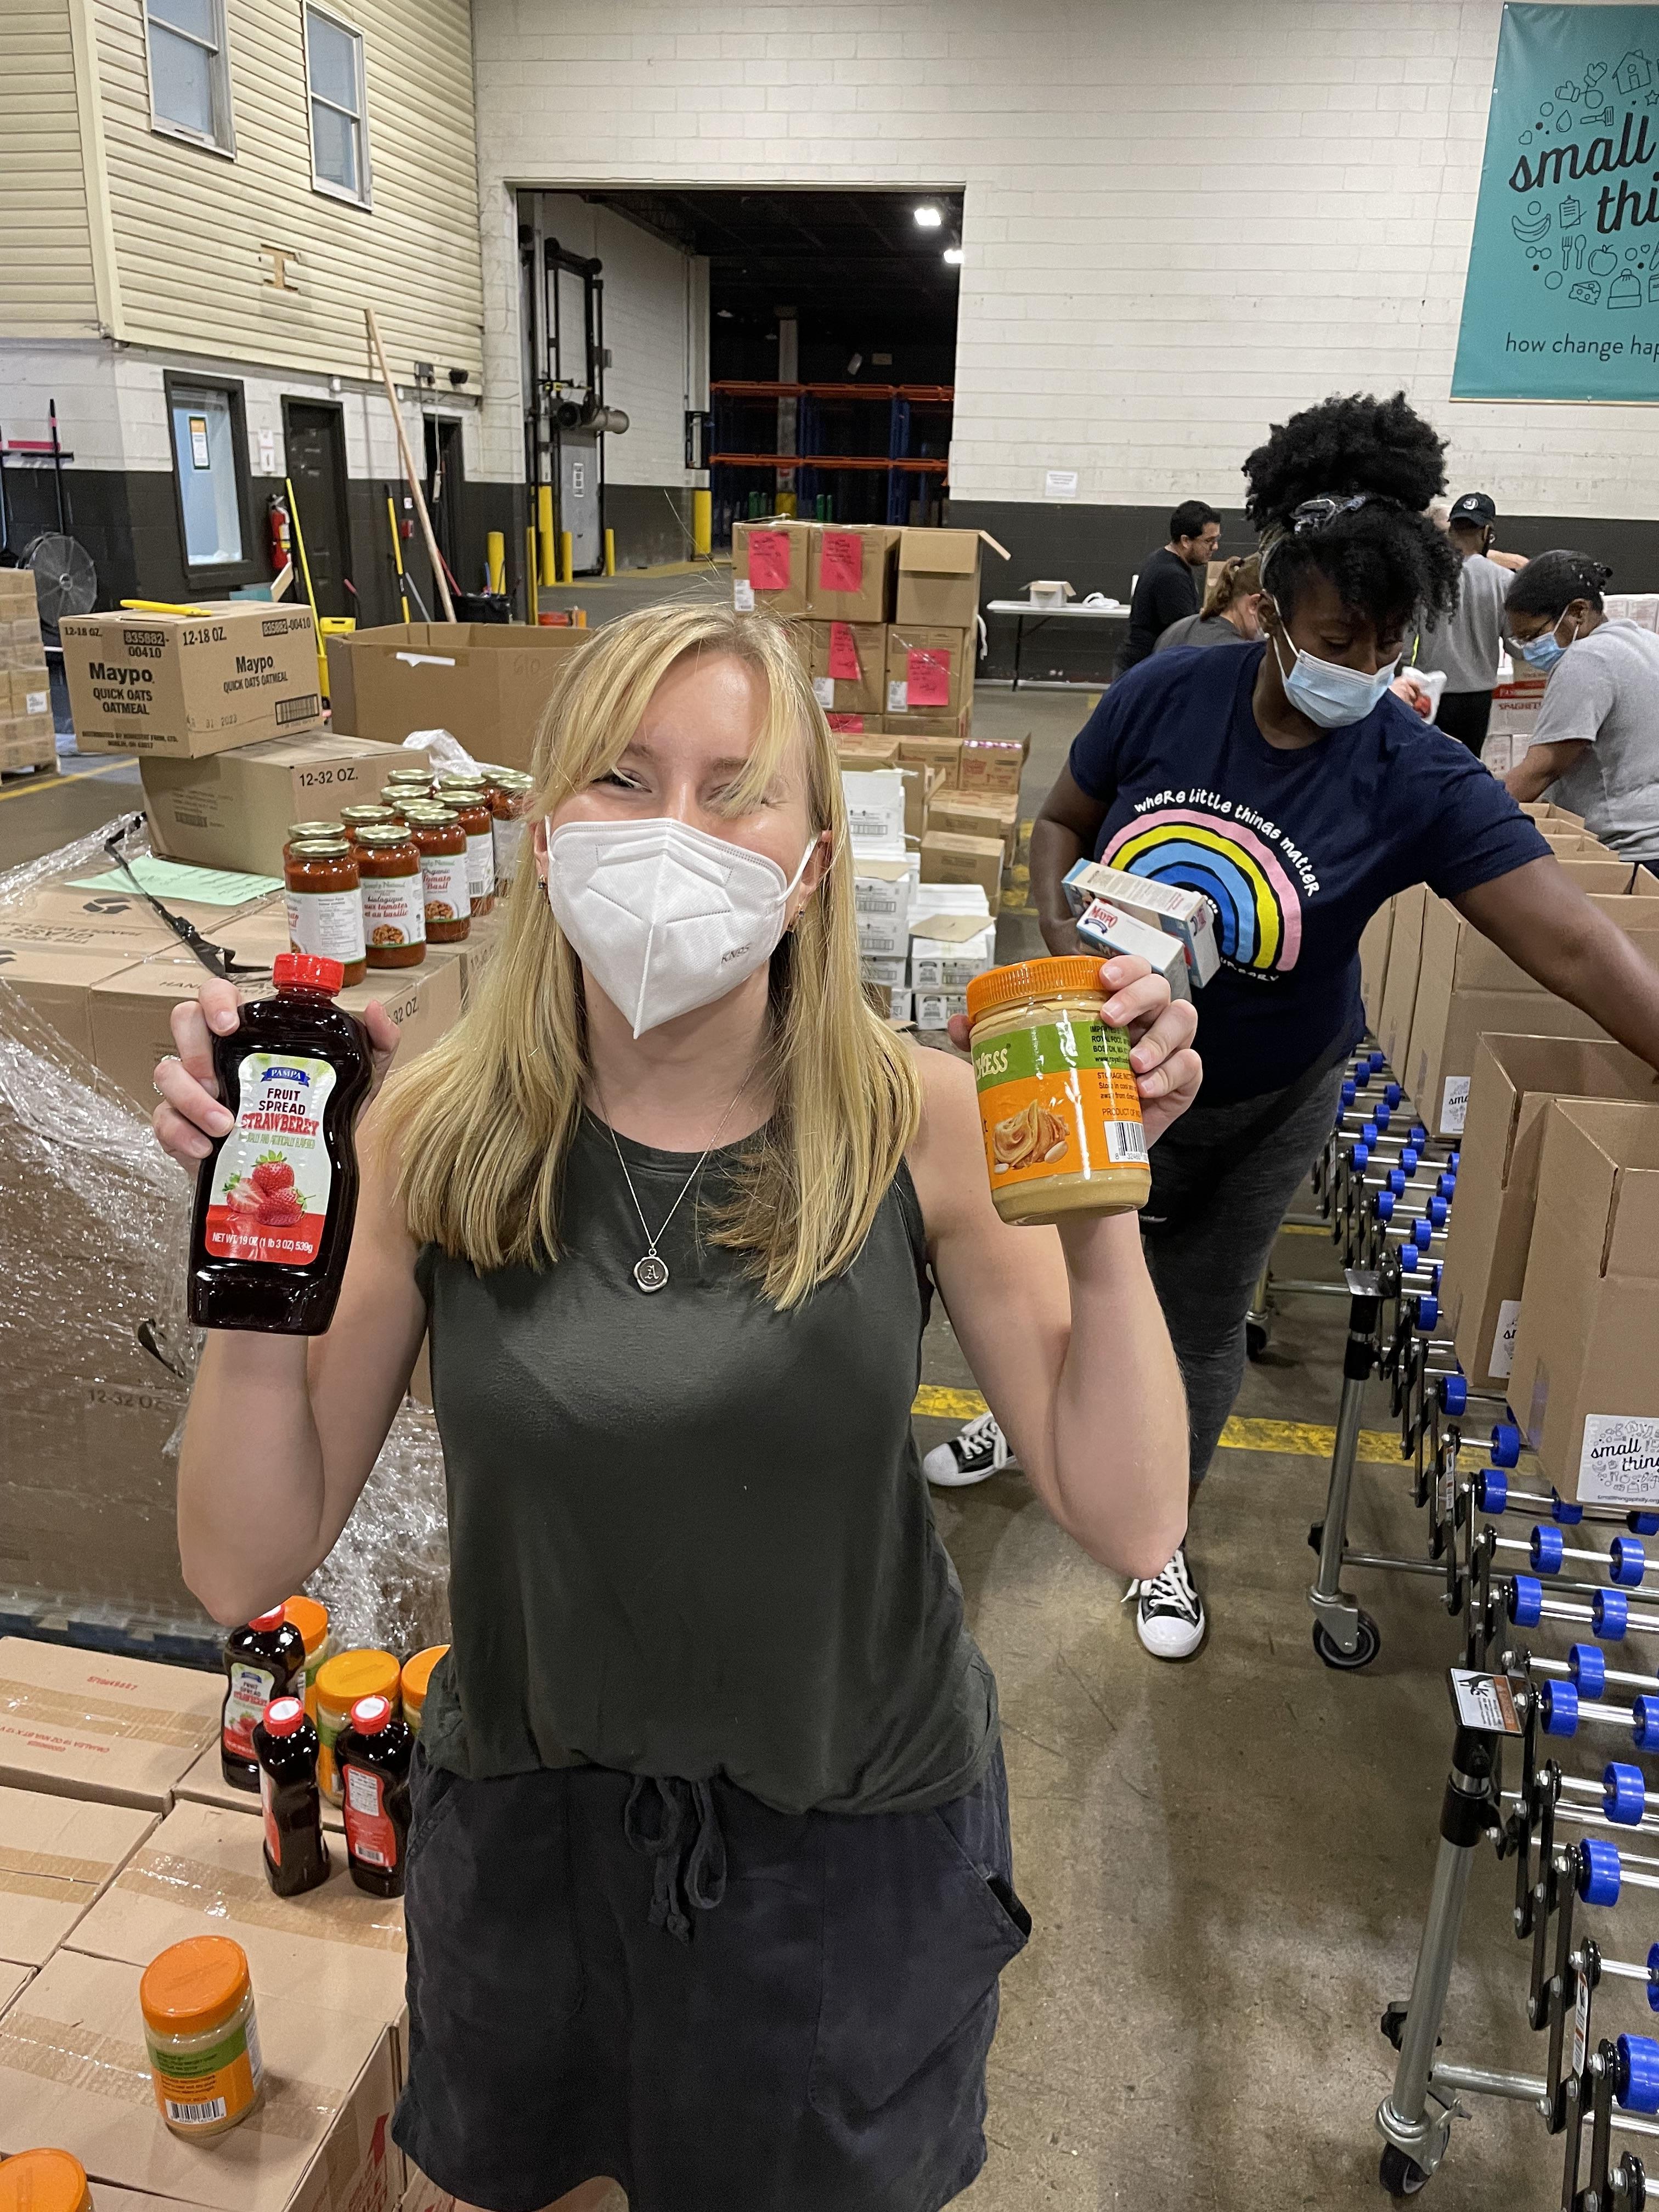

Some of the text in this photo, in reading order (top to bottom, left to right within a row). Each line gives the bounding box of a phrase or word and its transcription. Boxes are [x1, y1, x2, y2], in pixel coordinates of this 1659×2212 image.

[1509, 112, 1657, 193] small
[1506, 332, 1546, 352] how
[1553, 333, 1623, 362] change
[183, 628, 210, 646] 12-18
[128, 646, 162, 658] 00410
[89, 662, 153, 685] Maypo
[235, 655, 274, 674] Maypo
[223, 671, 288, 694] QUICK OATS OATMEAL
[93, 687, 153, 702] QUICK OATS
[103, 702, 150, 715] OATMEAL
[300, 768, 358, 787] 12-32 OZ.
[1188, 788, 1232, 813] little
[1234, 804, 1282, 839] things
[368, 893, 403, 904] biologique
[272, 1069, 301, 1080] PAMPA
[267, 1088, 301, 1102] FRUIT
[258, 1100, 306, 1115] SPREAD
[1102, 1108, 1130, 1116] PRODUCT
[212, 1232, 225, 1242] NET
[239, 1235, 248, 1245] 19
[249, 1237, 258, 1246] OZ
[259, 1237, 266, 1248] (1
[267, 1238, 274, 1248] lb
[275, 1239, 282, 1249] 3
[282, 1240, 294, 1252] OZ)
[295, 1241, 313, 1254] 539g
[1590, 1437, 1642, 1459] small
